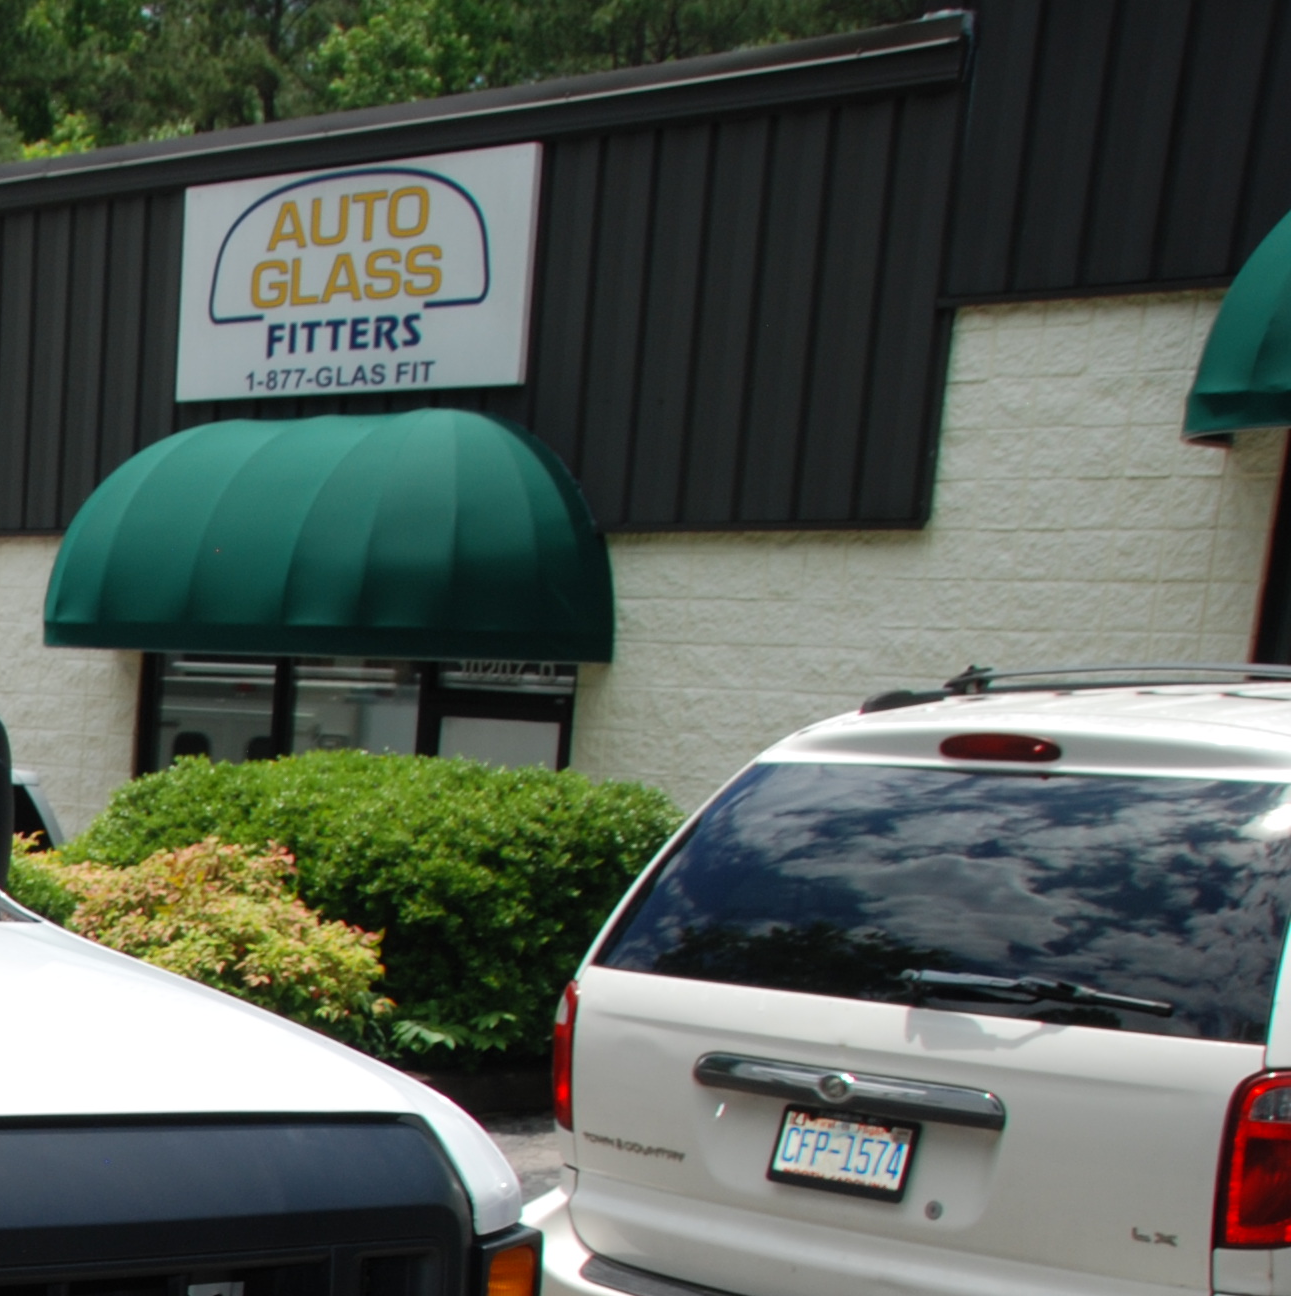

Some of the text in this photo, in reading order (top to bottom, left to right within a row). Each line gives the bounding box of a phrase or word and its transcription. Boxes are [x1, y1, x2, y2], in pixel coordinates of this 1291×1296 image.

[266, 185, 431, 253] AUTO
[249, 244, 444, 310] GLASS
[265, 313, 423, 360] FITTERS
[245, 360, 436, 392] 1-877-GLAS FIT
[780, 1126, 905, 1180] CFP-1574
